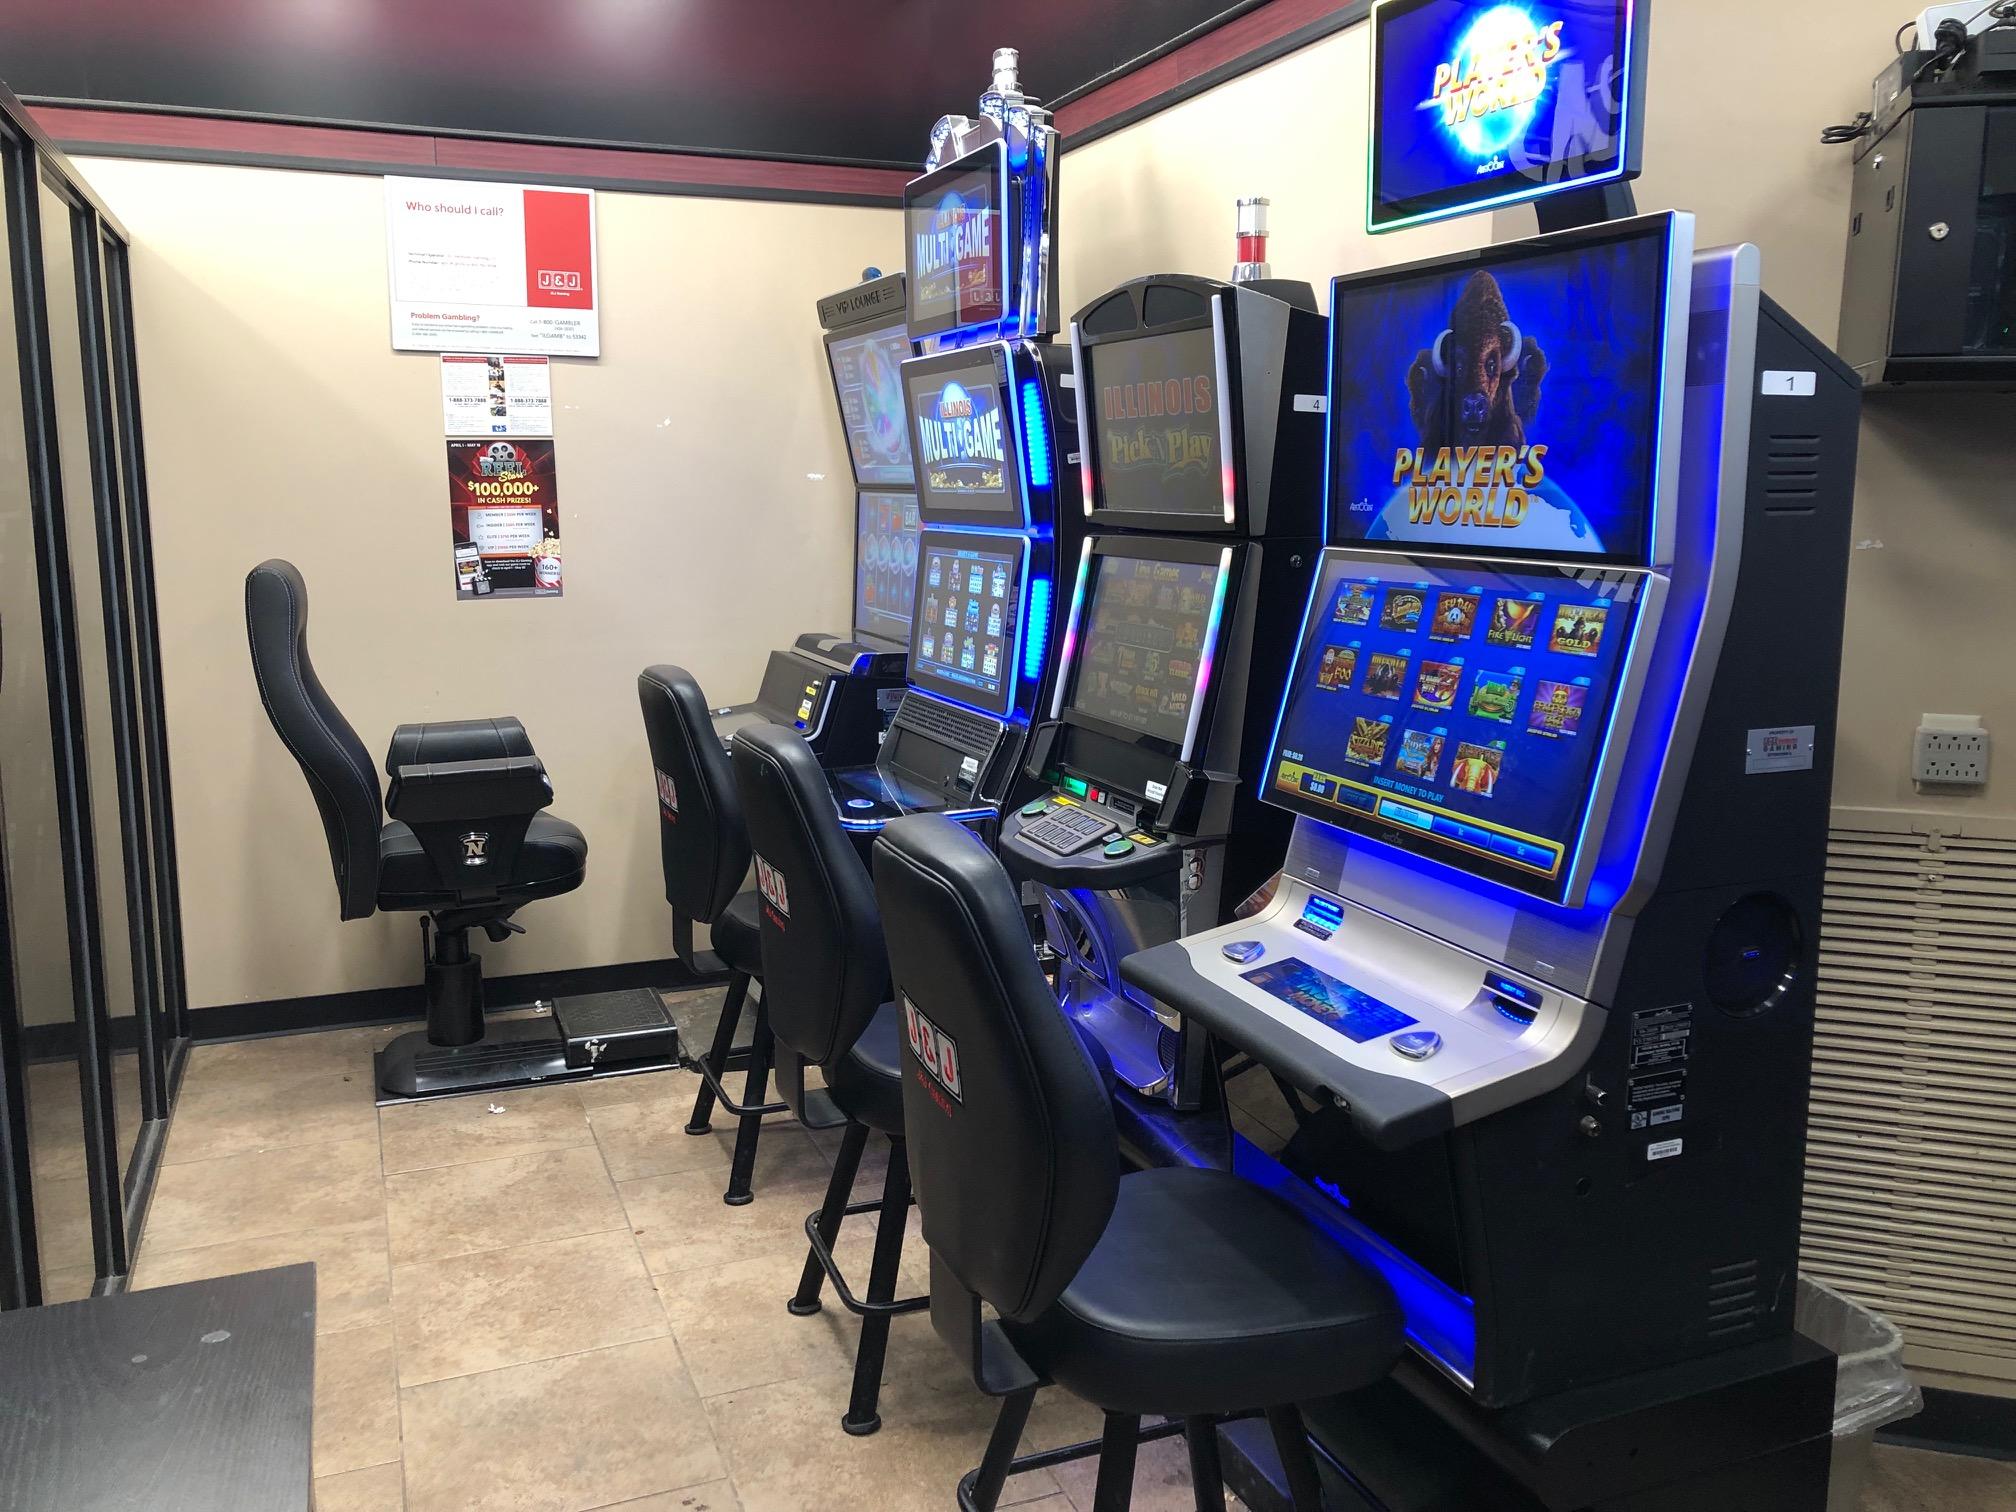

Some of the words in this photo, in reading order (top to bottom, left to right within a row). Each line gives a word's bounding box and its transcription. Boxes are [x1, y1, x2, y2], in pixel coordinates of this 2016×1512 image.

[405, 201, 432, 213] Who
[434, 203, 471, 215] should
[480, 205, 504, 217] call?
[916, 231, 950, 280] MULTI
[955, 206, 990, 262] GAME
[540, 273, 578, 288] J&J
[849, 290, 881, 311] LOUNGE
[410, 312, 441, 320] Problem
[441, 313, 481, 323] Gambling?
[1786, 376, 1795, 391] 1
[1103, 375, 1212, 420] ILLINOIS
[1313, 399, 1321, 411] 4
[940, 399, 973, 418] ILLINOIS
[918, 415, 959, 464] MULTI
[963, 407, 1005, 462] GAME
[1107, 426, 1151, 465] Pick
[1166, 424, 1212, 470] Play
[480, 461, 523, 476] REEL
[1392, 444, 1548, 489] PLAYER'S
[467, 480, 539, 496] $100,000+
[1408, 487, 1529, 528] WORLD
[904, 509, 916, 526] BAR
[1488, 629, 1504, 640] FIRE
[1512, 632, 1533, 643] LIGHT
[1557, 637, 1591, 649] GOLD
[1373, 775, 1395, 788] INSERT
[1395, 782, 1418, 795] MONEY
[1418, 788, 1428, 798] TO
[1427, 791, 1445, 803] PLAY
[464, 840, 486, 856] N
[907, 1003, 956, 1088] J&J
